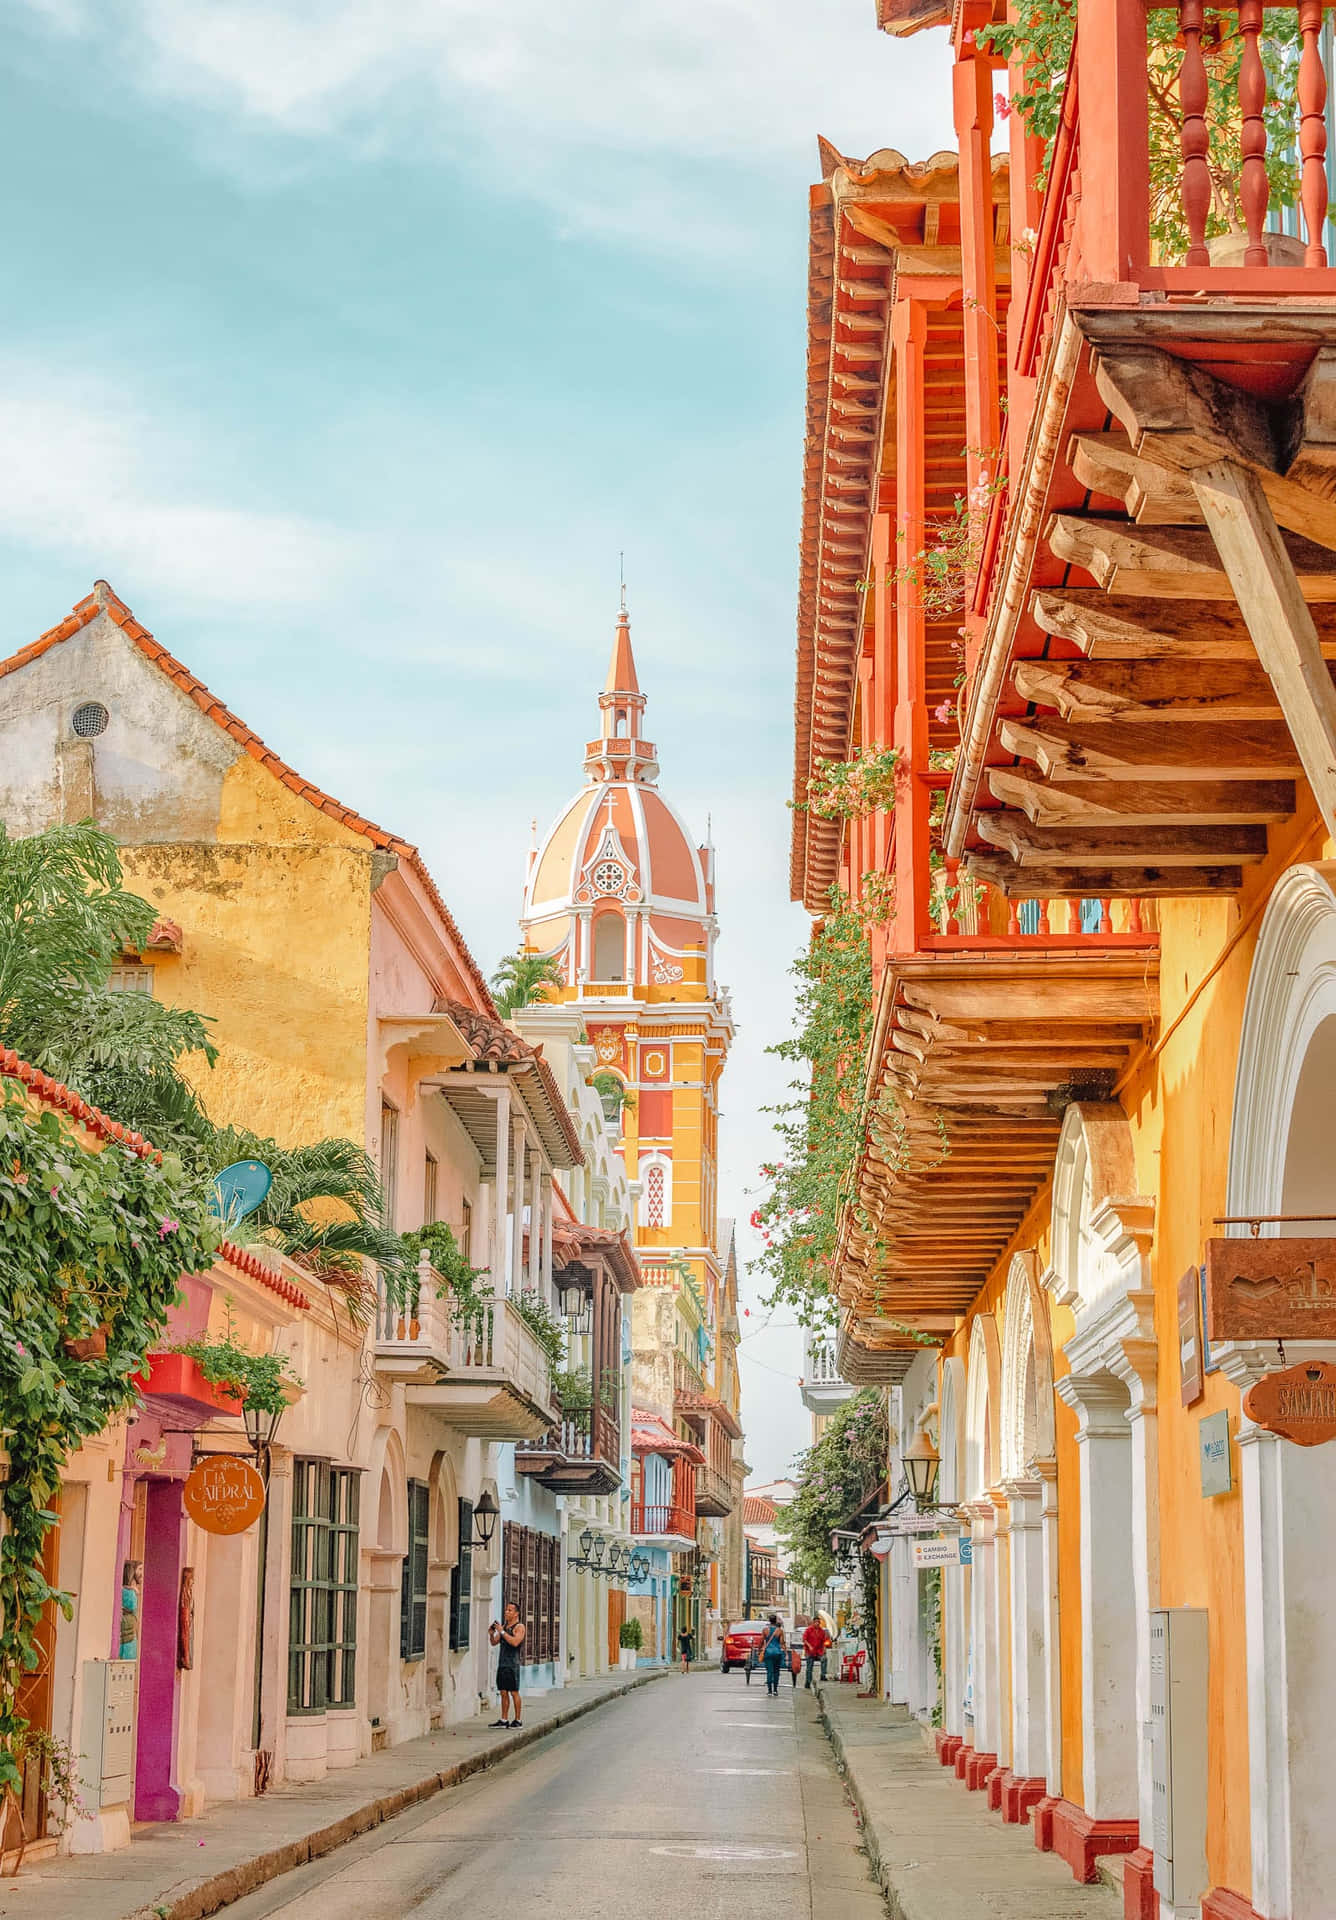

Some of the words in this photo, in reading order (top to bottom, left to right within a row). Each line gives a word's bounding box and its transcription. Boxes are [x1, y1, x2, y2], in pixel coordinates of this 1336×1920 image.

[214, 1471, 226, 1484] LA
[191, 1483, 257, 1502] CATEDRAL
[923, 1545, 948, 1553] CAMBIO
